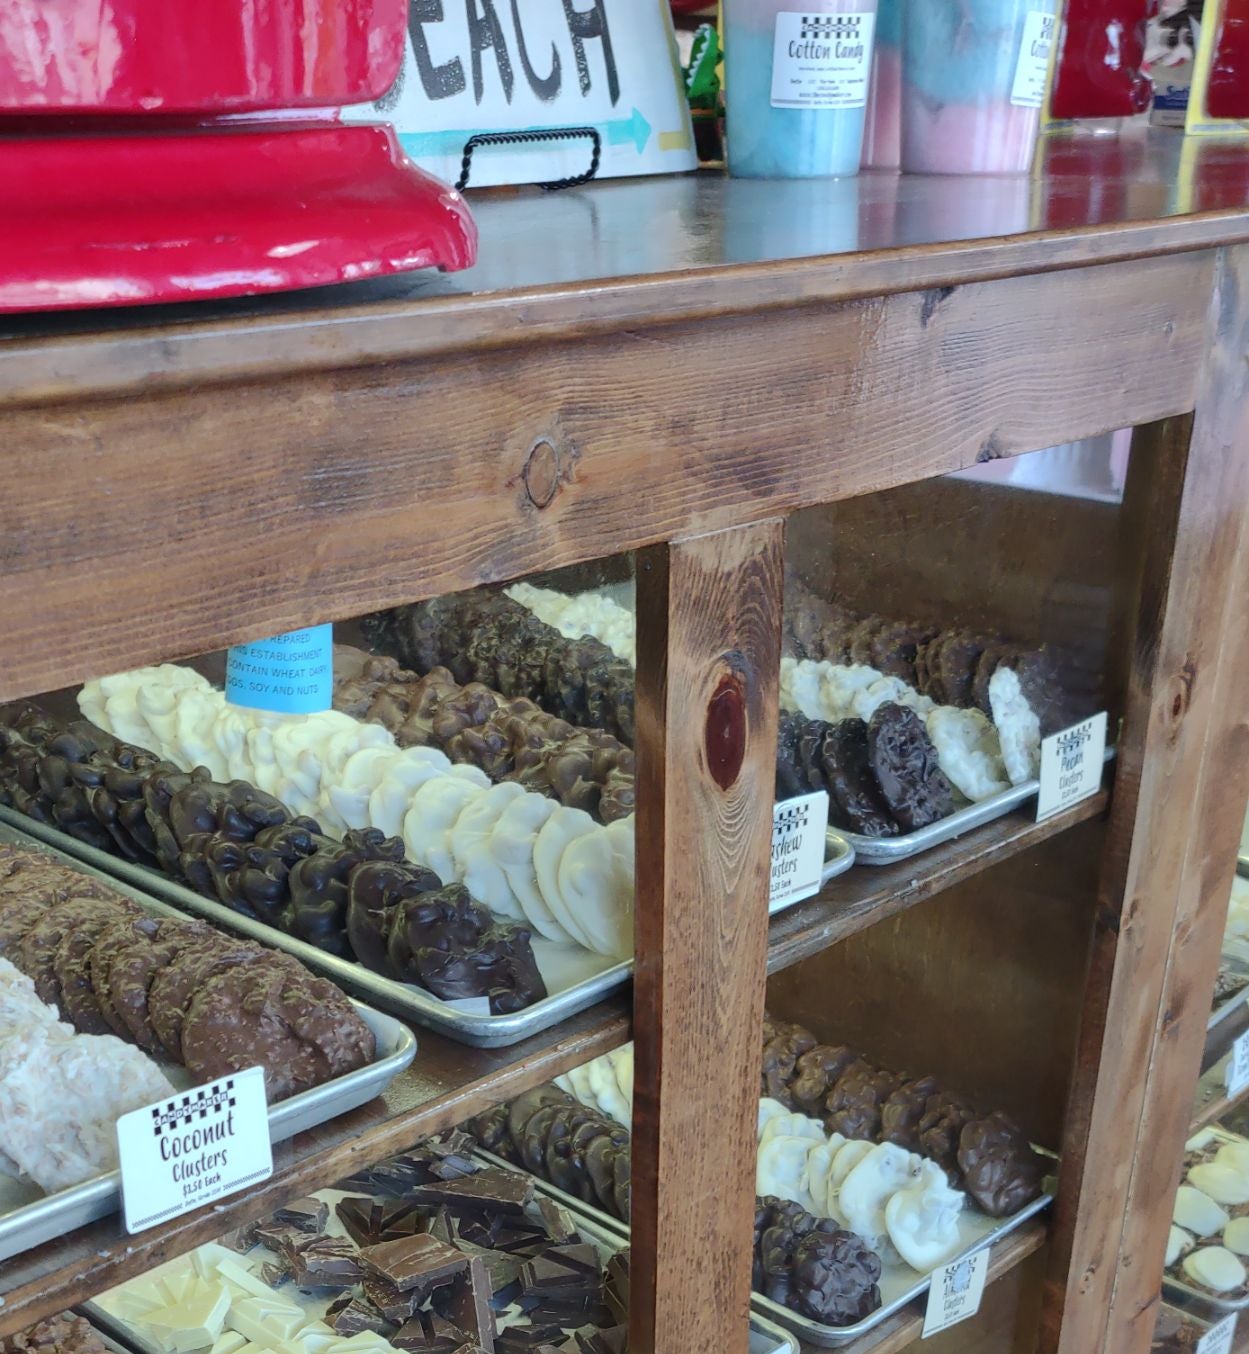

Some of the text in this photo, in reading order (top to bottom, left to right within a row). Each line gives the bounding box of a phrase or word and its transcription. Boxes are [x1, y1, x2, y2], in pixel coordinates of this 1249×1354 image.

[374, 0, 620, 111] EACH
[788, 40, 831, 60] Cotton
[250, 648, 322, 662] ESTABLISHMENT
[271, 668, 306, 679] WHEAT
[272, 684, 295, 696] AND
[296, 684, 319, 696] NUTS
[160, 1110, 235, 1162] Coconut
[172, 1149, 228, 1183] Clusters
